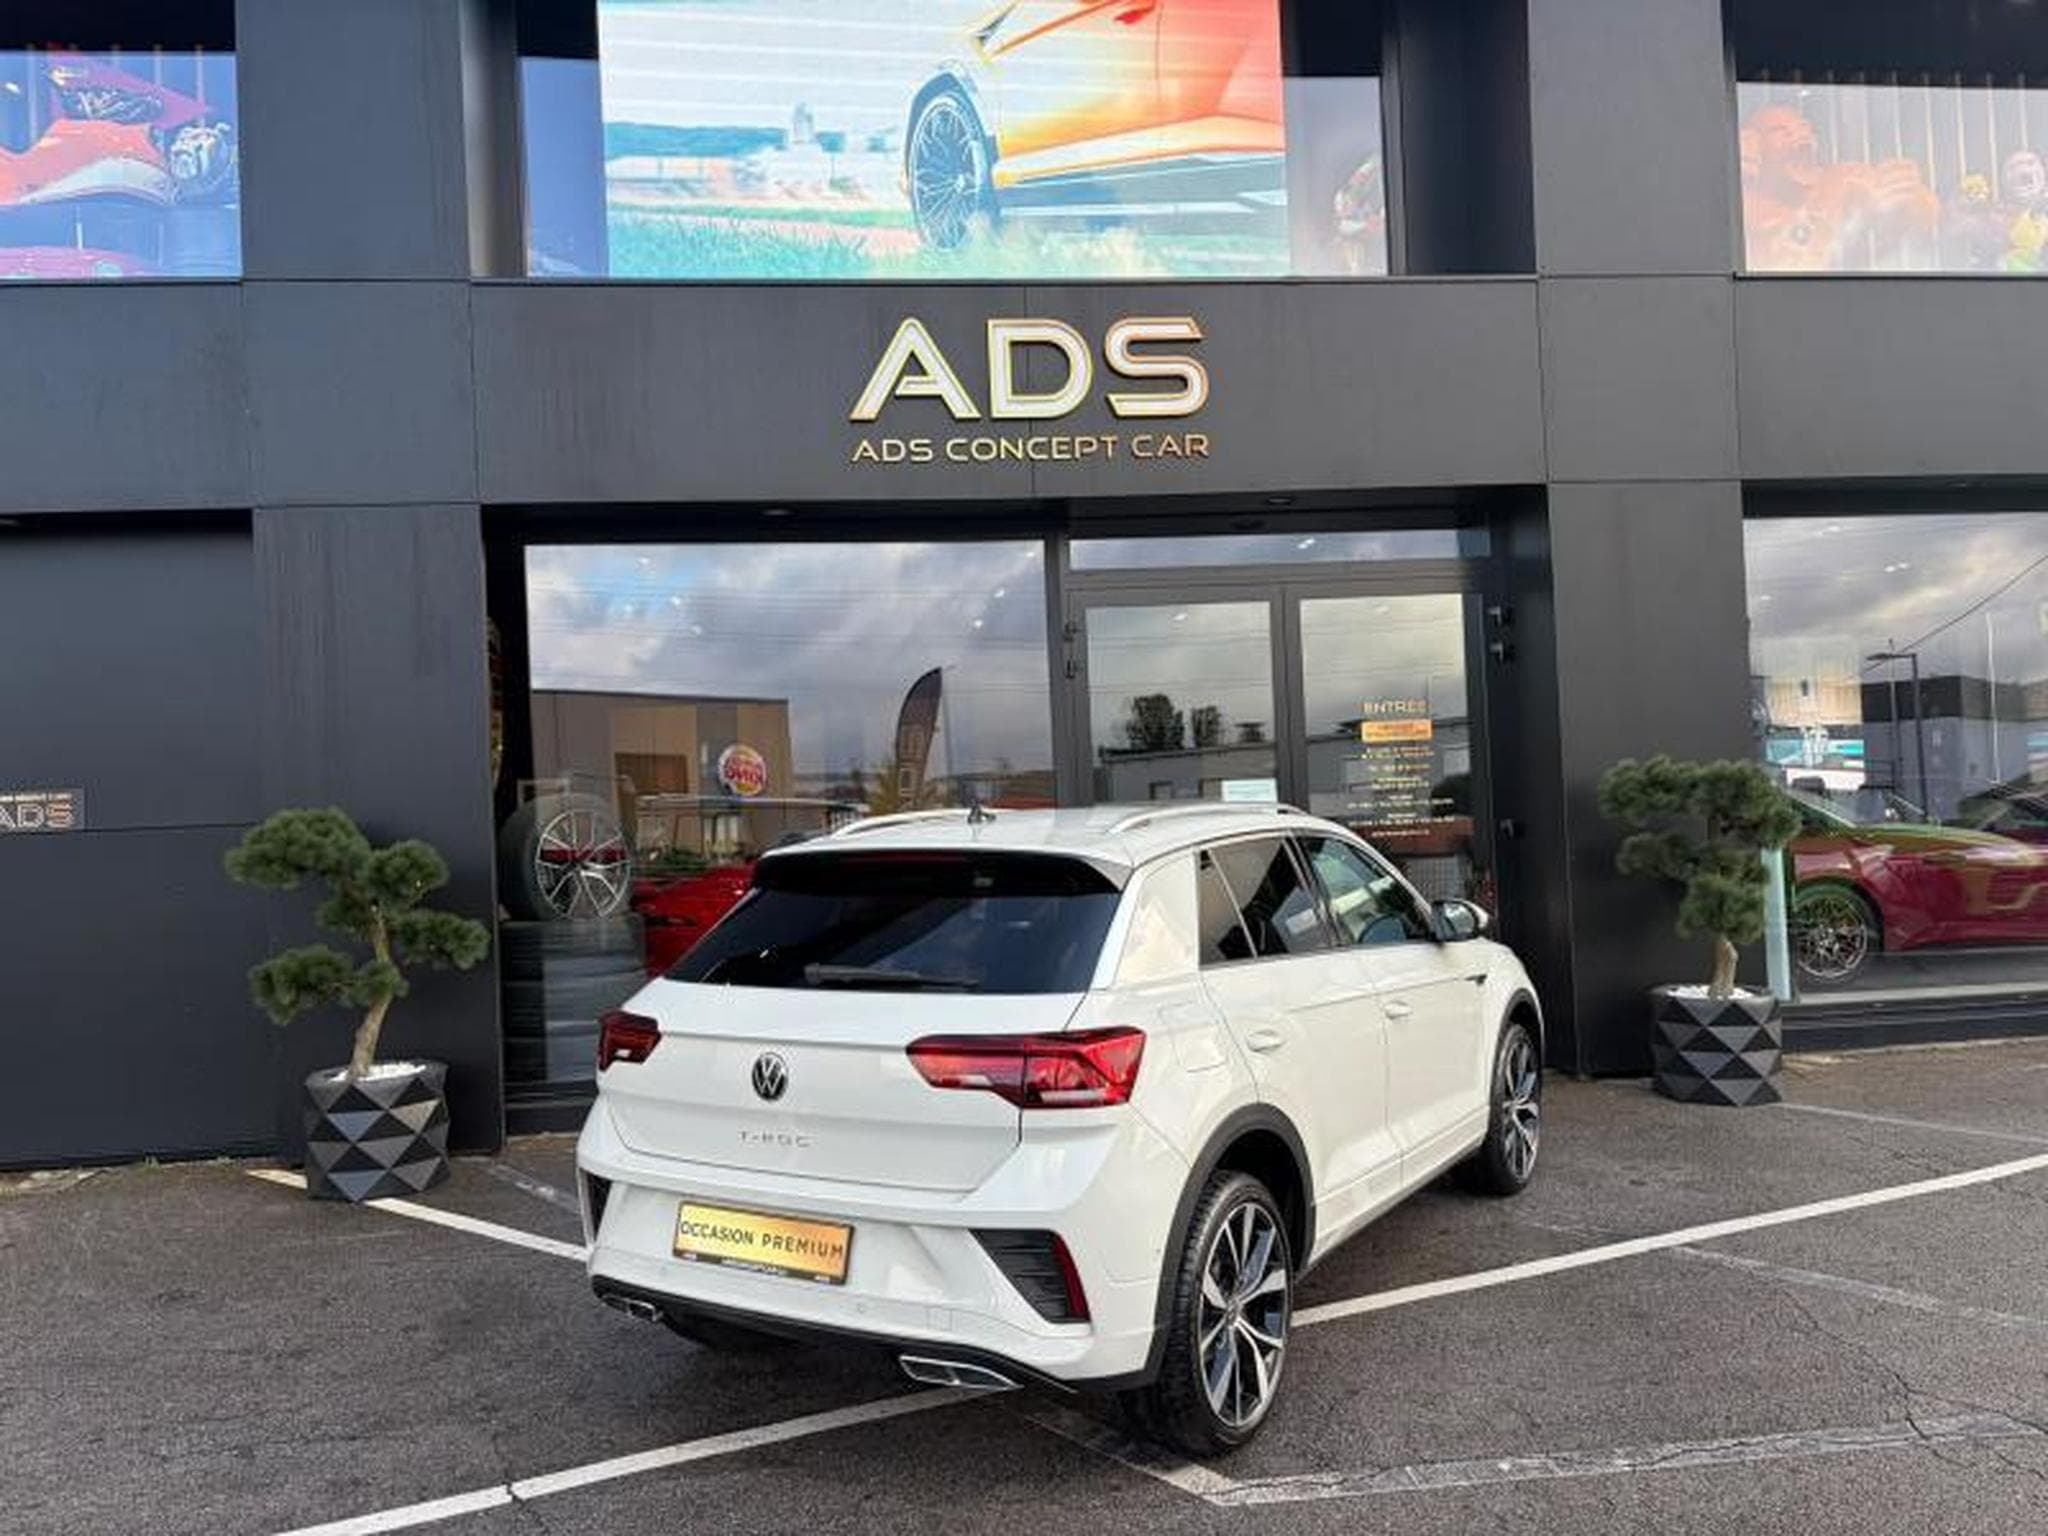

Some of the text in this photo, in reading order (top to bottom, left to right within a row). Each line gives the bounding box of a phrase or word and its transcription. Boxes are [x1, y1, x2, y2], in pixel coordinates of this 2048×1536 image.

[849, 316, 1209, 421] ADS
[851, 433, 1210, 463] ADS CONCEPT CAR
[680, 1219, 844, 1259] OCCASION PREMIUM
